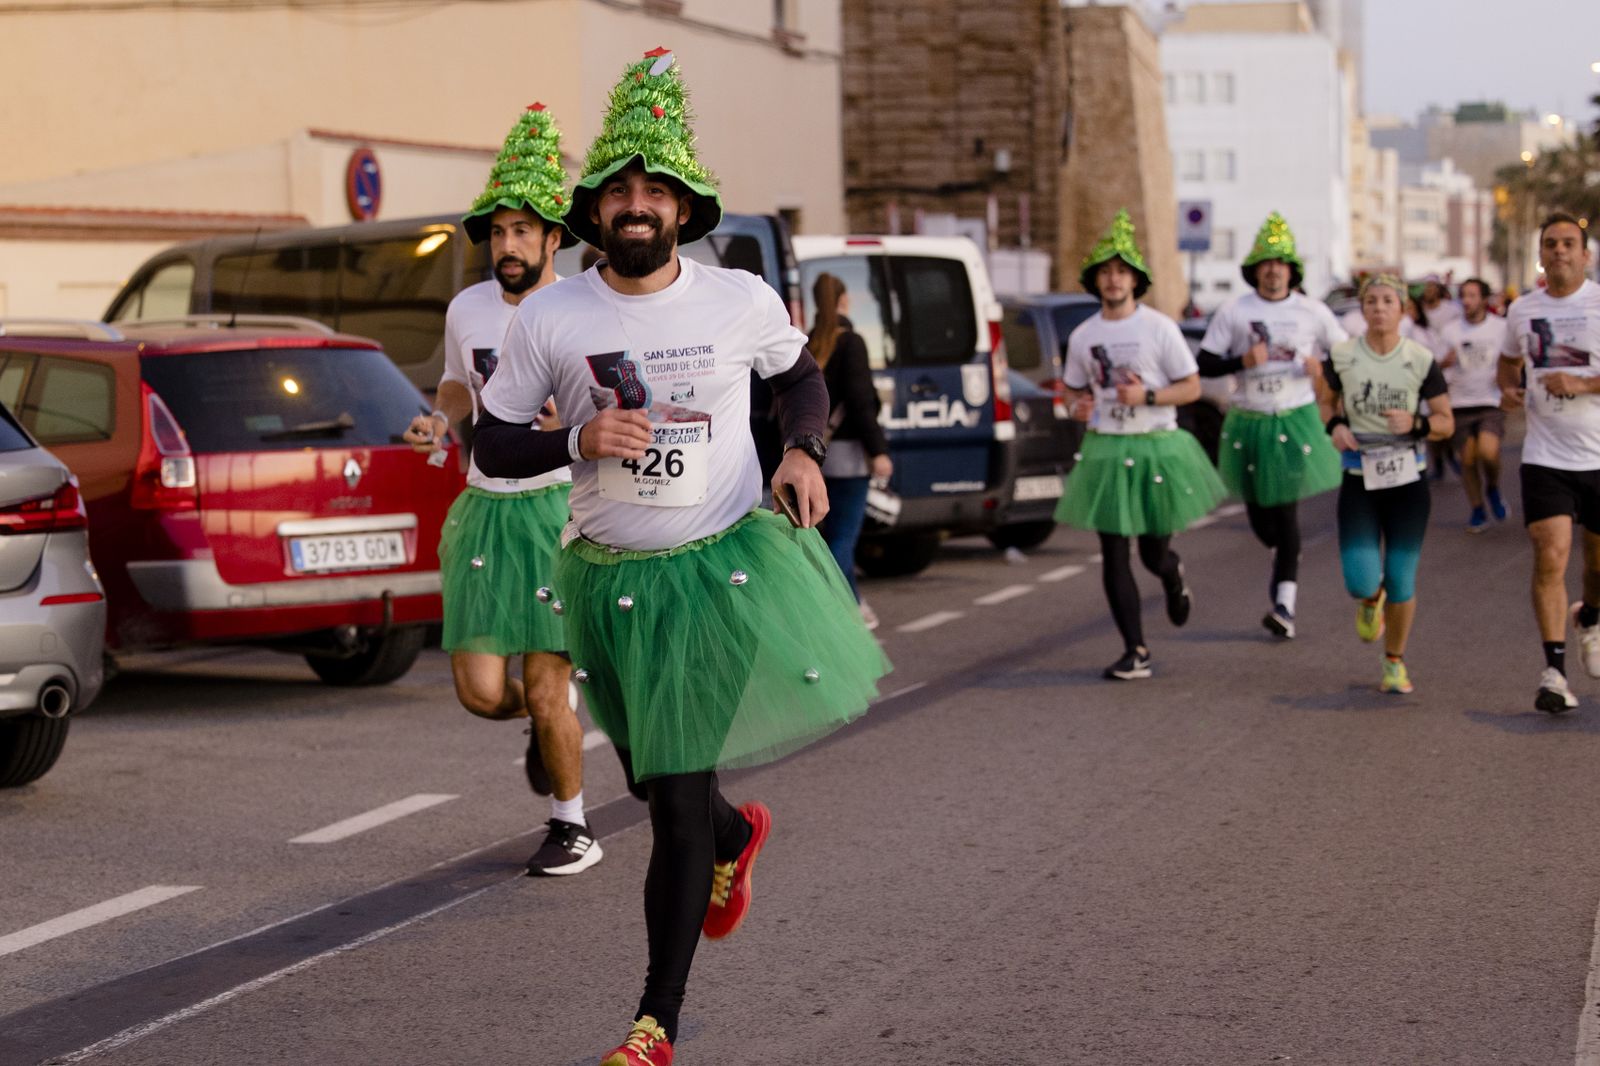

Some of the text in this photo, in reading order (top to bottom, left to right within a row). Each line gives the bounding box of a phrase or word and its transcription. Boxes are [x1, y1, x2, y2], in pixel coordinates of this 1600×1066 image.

[643, 344, 715, 361] SAN SILVESTRE
[645, 357, 715, 375] CIUDAD DE CÁDIZ
[647, 375, 668, 383] JUEVES
[877, 394, 972, 430] LICÍA
[650, 427, 701, 436] VESTRE
[621, 447, 684, 478] 426
[1376, 457, 1405, 476] 647
[307, 540, 359, 564] 3783
